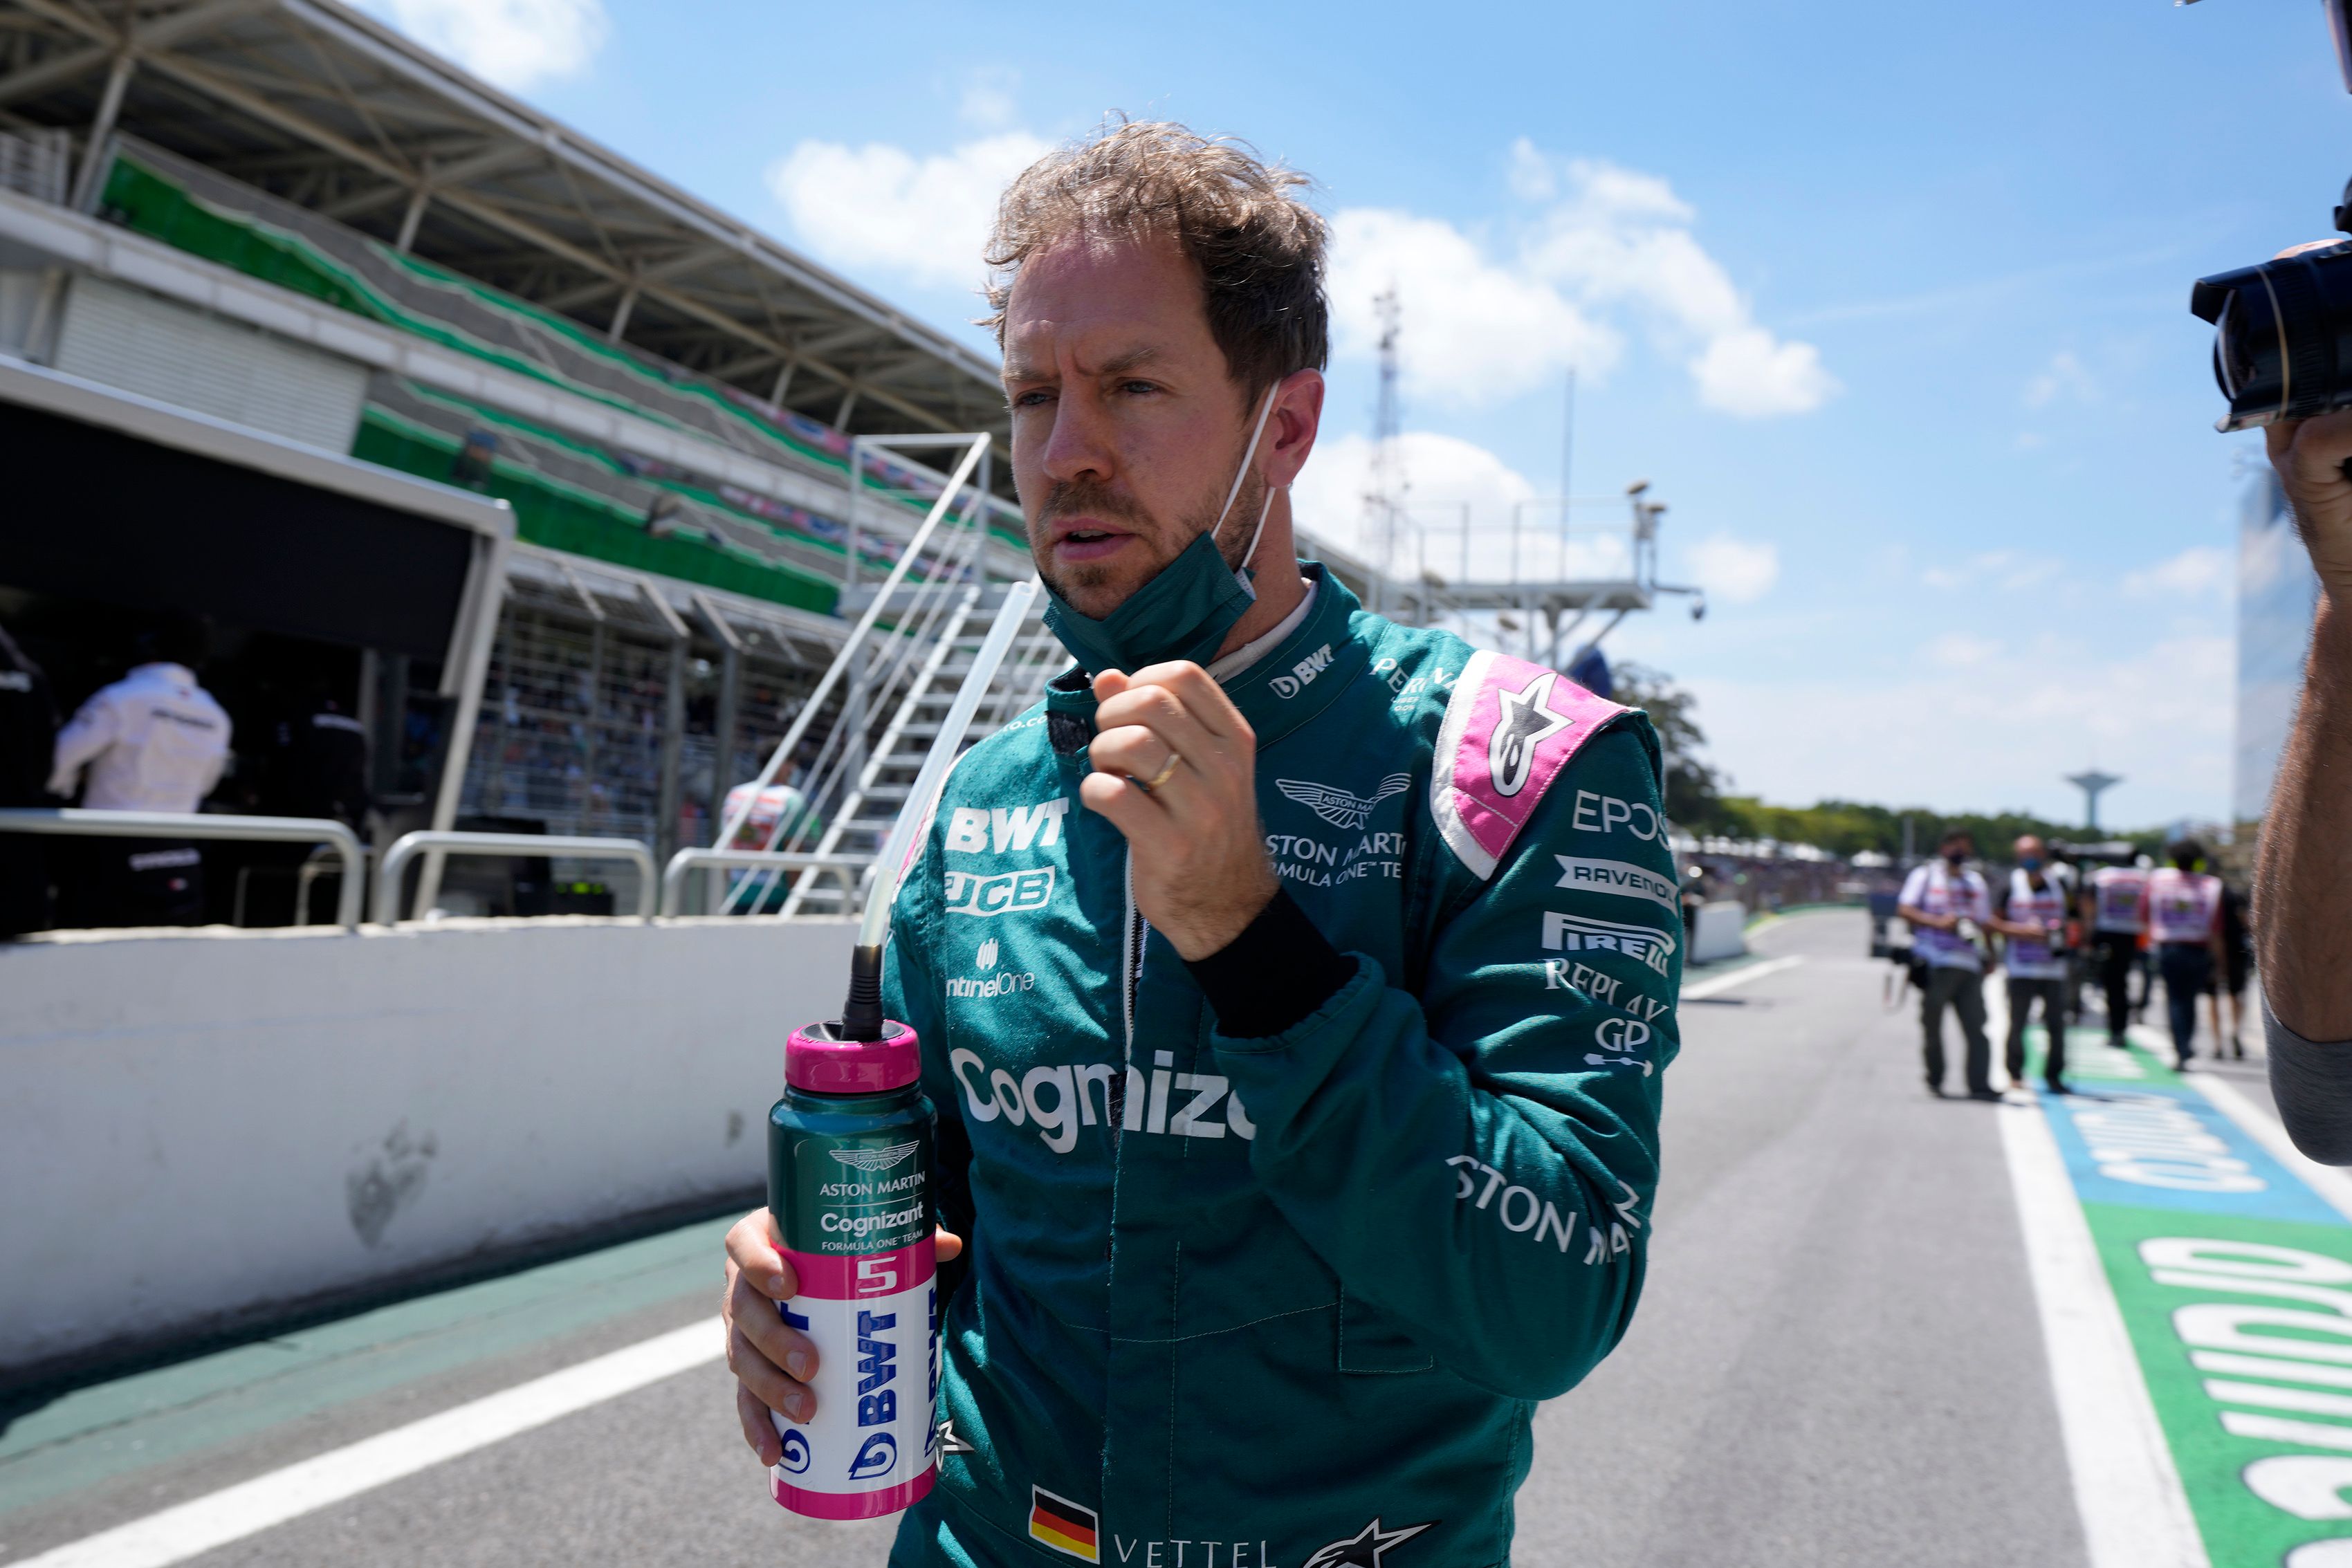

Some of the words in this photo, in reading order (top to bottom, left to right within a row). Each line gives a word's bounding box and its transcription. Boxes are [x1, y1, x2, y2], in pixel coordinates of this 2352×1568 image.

[1292, 643, 1336, 685] BWT
[1322, 795, 1357, 809] ASTON
[944, 797, 1069, 854] BWT
[1265, 834, 1339, 867] STON
[1379, 861, 1403, 878] TE
[944, 872, 1050, 912] JCB
[946, 971, 1036, 998] ntinelOne
[1594, 1017, 1651, 1053] GP
[819, 1183, 873, 1197] ASTON
[877, 1170, 926, 1195] MARTIN
[820, 1201, 924, 1237] Cognizant
[1444, 1154, 1578, 1253] STON
[821, 1241, 874, 1251] FORMULA
[902, 1228, 924, 1243] TEAM
[856, 1255, 897, 1293] 5
[857, 1309, 897, 1428] BWT
[1114, 1533, 1277, 1568] VETTEL
